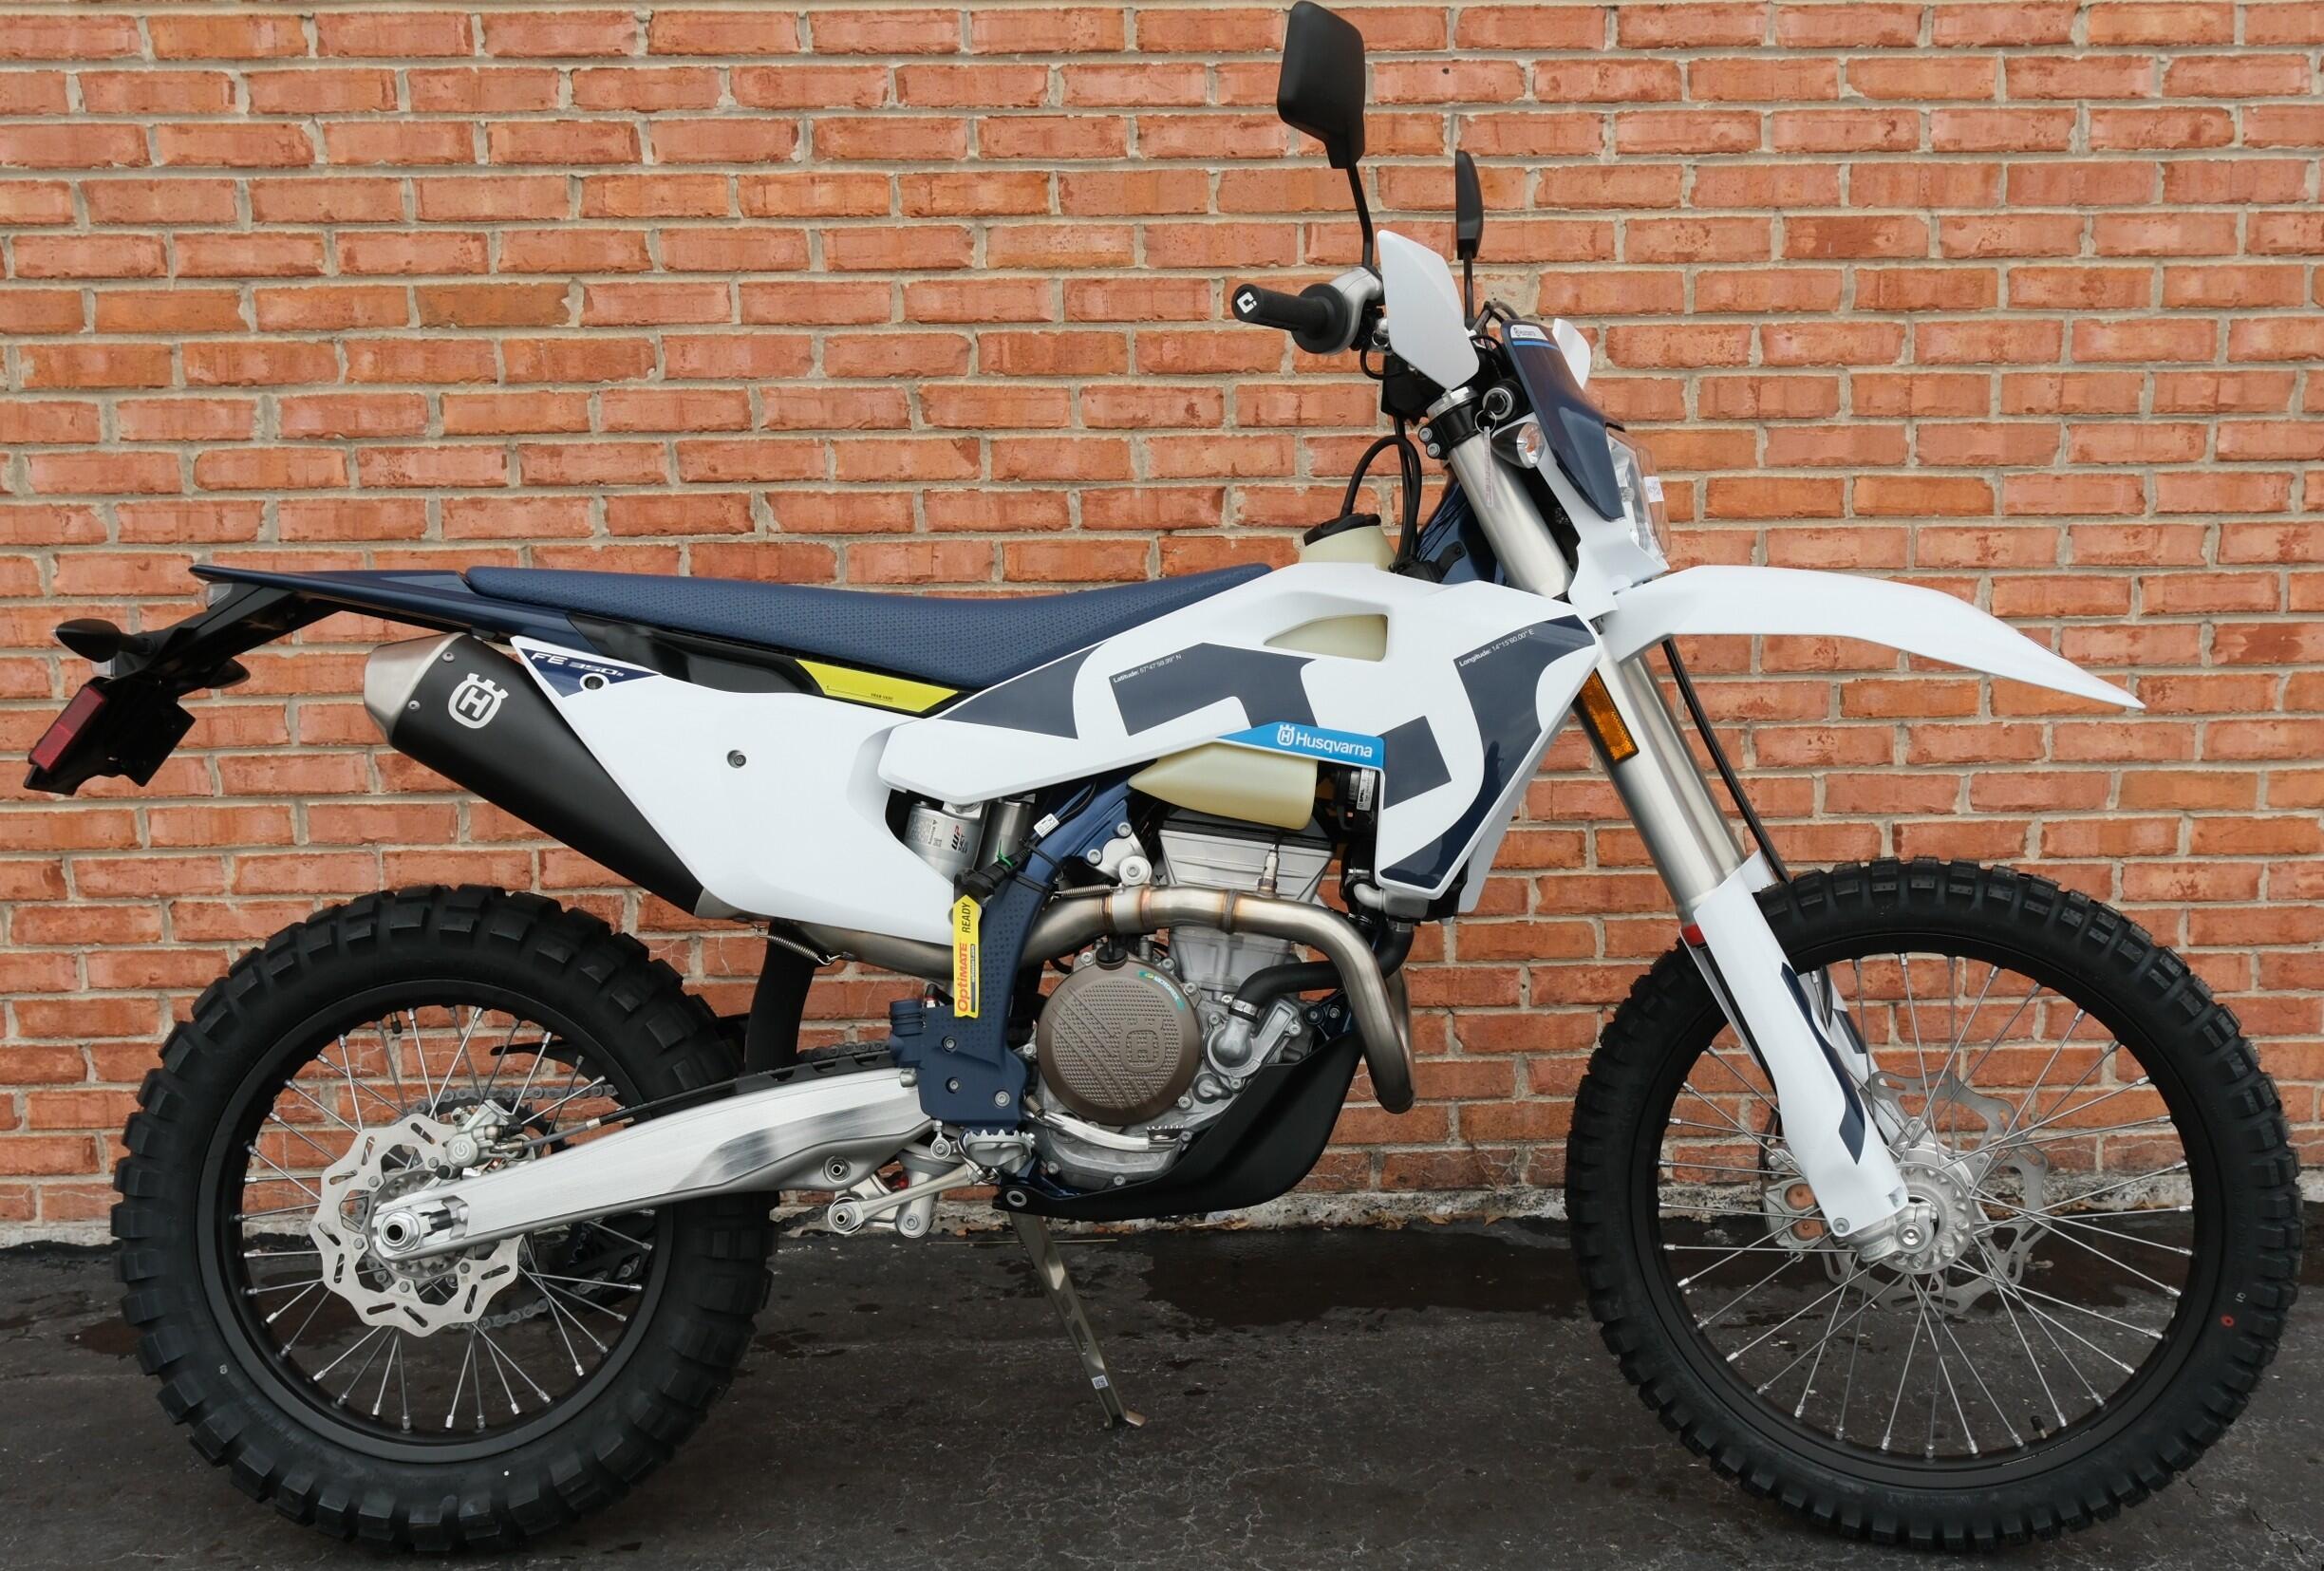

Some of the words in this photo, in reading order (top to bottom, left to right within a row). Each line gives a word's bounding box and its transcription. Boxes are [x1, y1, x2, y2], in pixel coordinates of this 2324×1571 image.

[531, 652, 569, 665] FE
[1458, 648, 1491, 667] Longitude:
[1113, 669, 1140, 683] Latitude:
[1295, 731, 1374, 758] Husqvarna
[961, 902, 971, 934] READY
[957, 942, 970, 1013] OptiMATE
